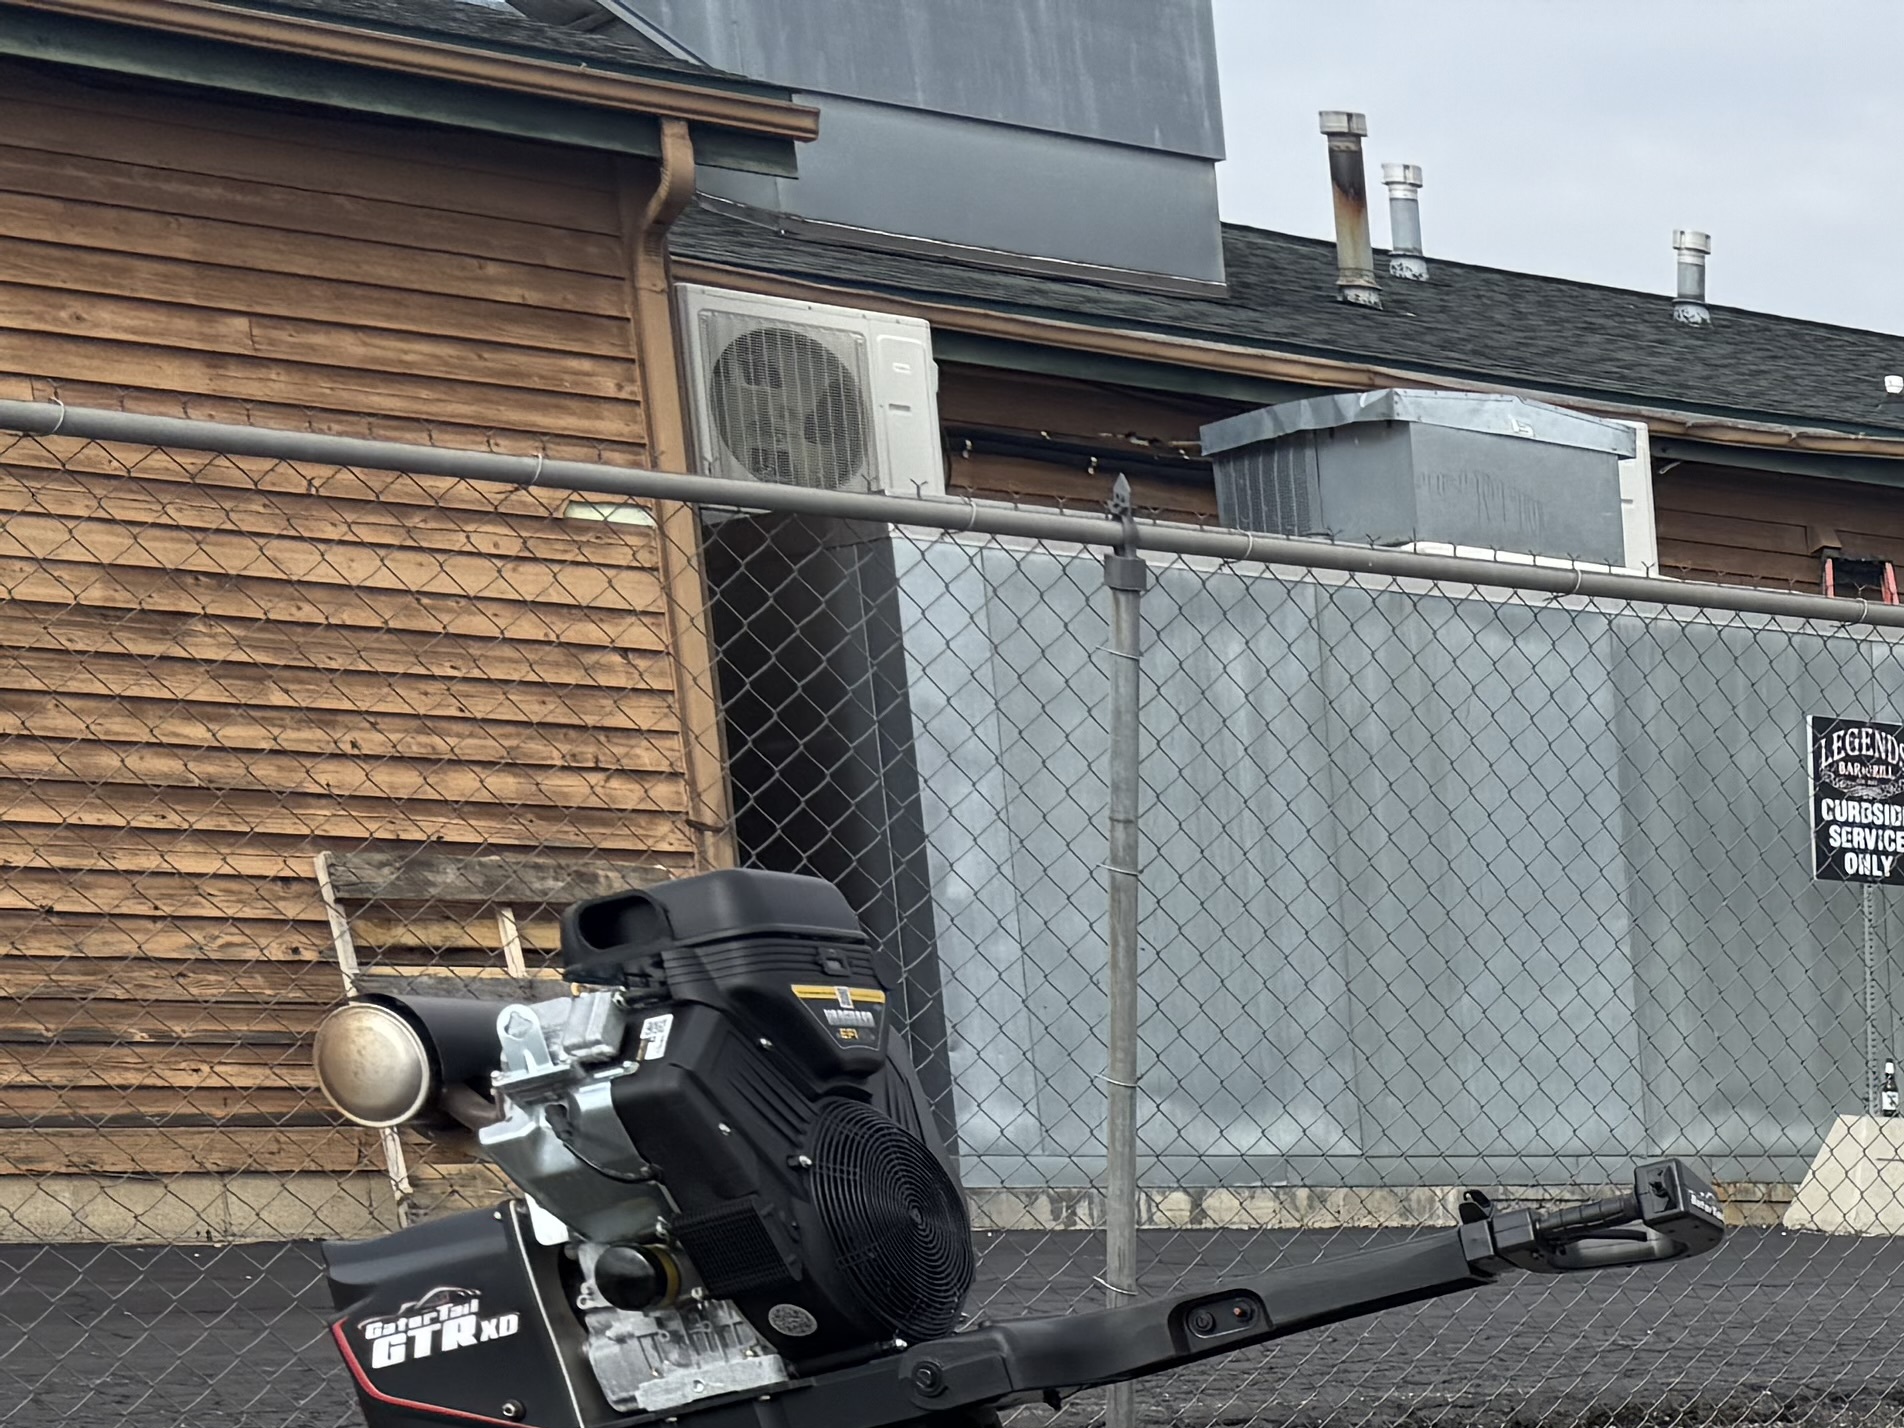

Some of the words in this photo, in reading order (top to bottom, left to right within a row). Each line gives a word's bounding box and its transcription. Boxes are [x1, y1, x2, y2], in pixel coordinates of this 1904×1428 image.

[1844, 852, 1894, 878] ONLY
[371, 1314, 479, 1369] GTR
[480, 1313, 519, 1342] XD
